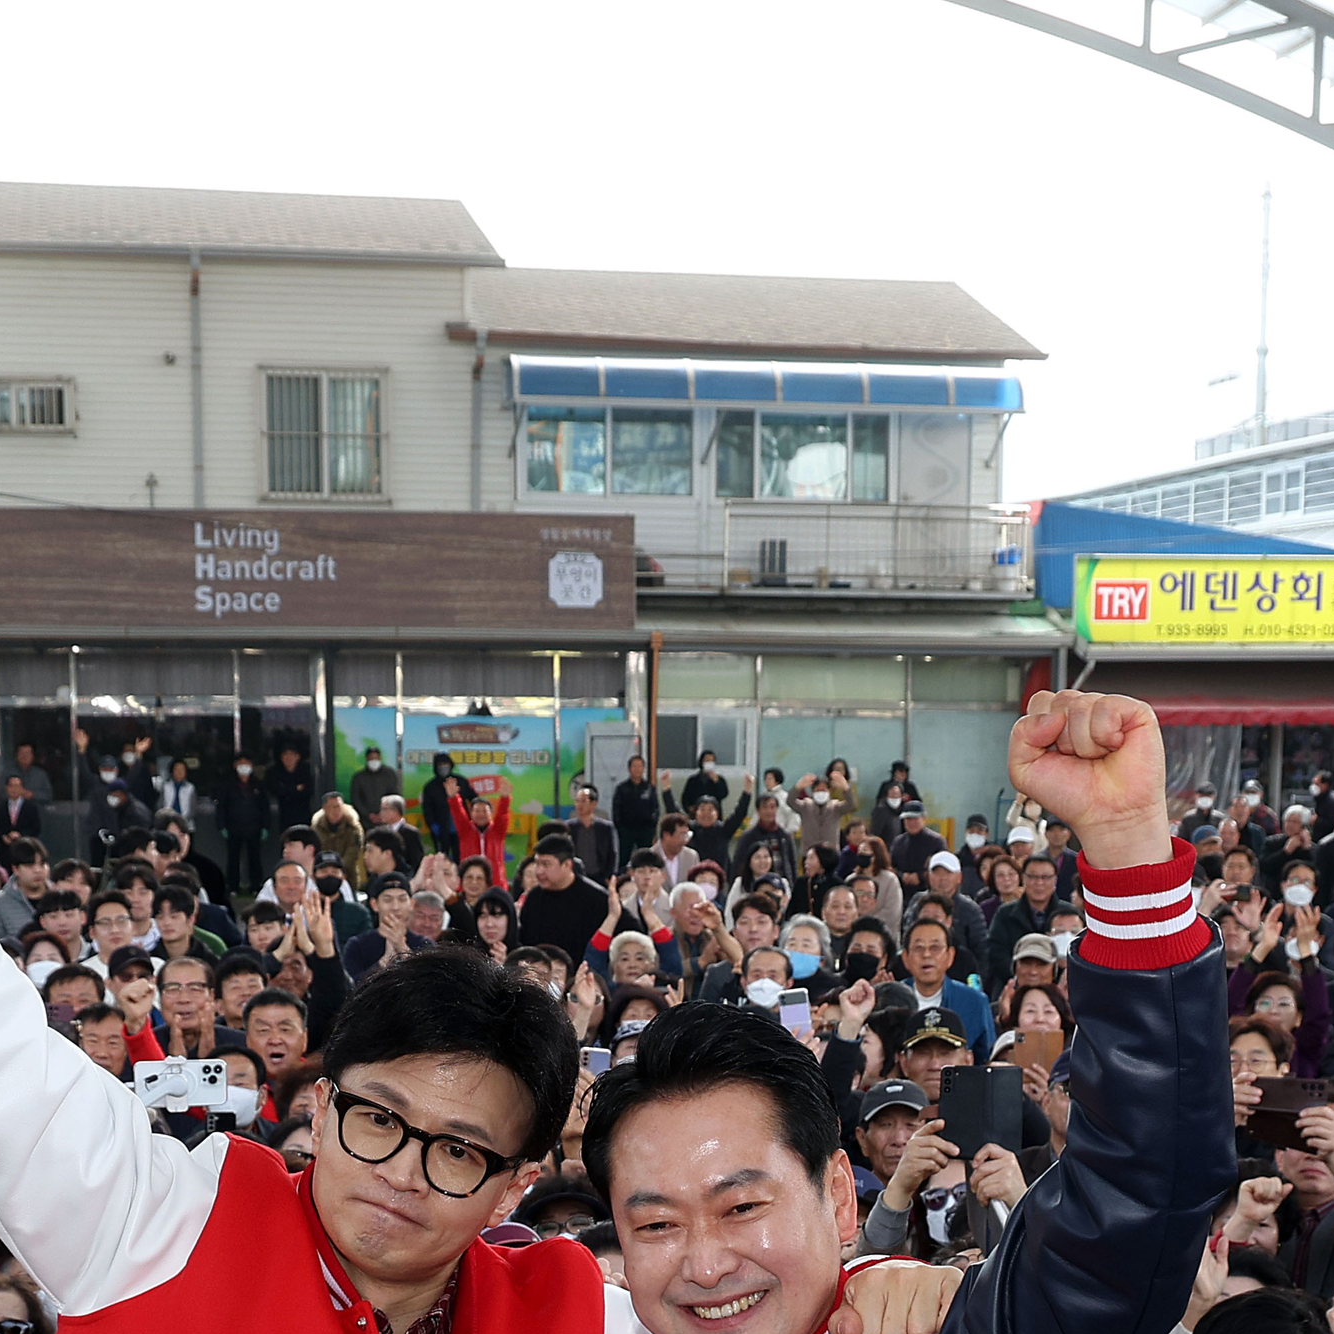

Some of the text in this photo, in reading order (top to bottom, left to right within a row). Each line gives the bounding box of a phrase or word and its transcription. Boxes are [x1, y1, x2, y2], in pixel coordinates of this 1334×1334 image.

[194, 520, 281, 556] Living
[194, 553, 337, 581] Handcraft
[194, 585, 282, 619] Space
[1097, 585, 1146, 617] TRY
[1159, 571, 1324, 613] 에덴상회
